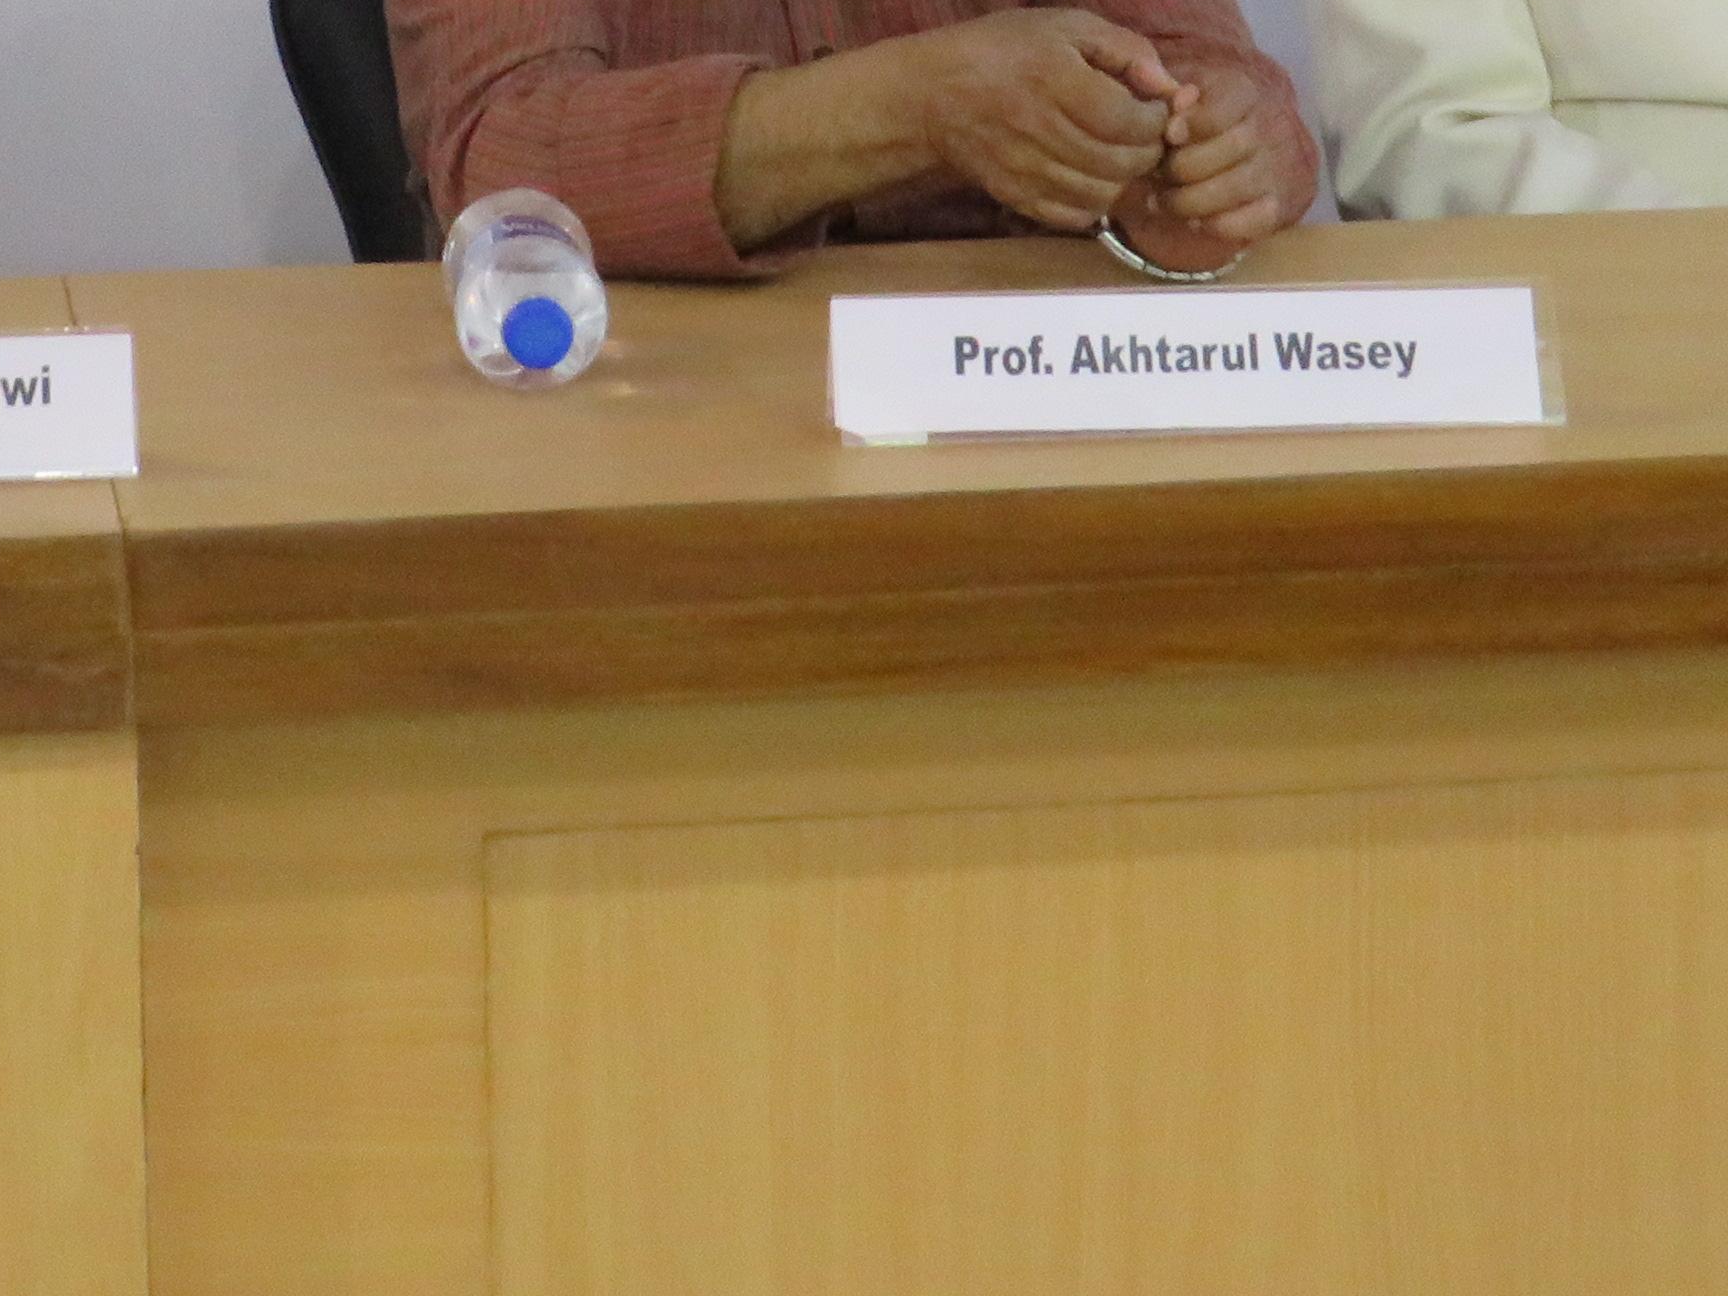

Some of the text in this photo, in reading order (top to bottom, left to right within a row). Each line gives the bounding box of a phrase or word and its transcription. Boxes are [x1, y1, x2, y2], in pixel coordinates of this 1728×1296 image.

[952, 330, 1418, 380] Prof. Akhtarul Wasey
